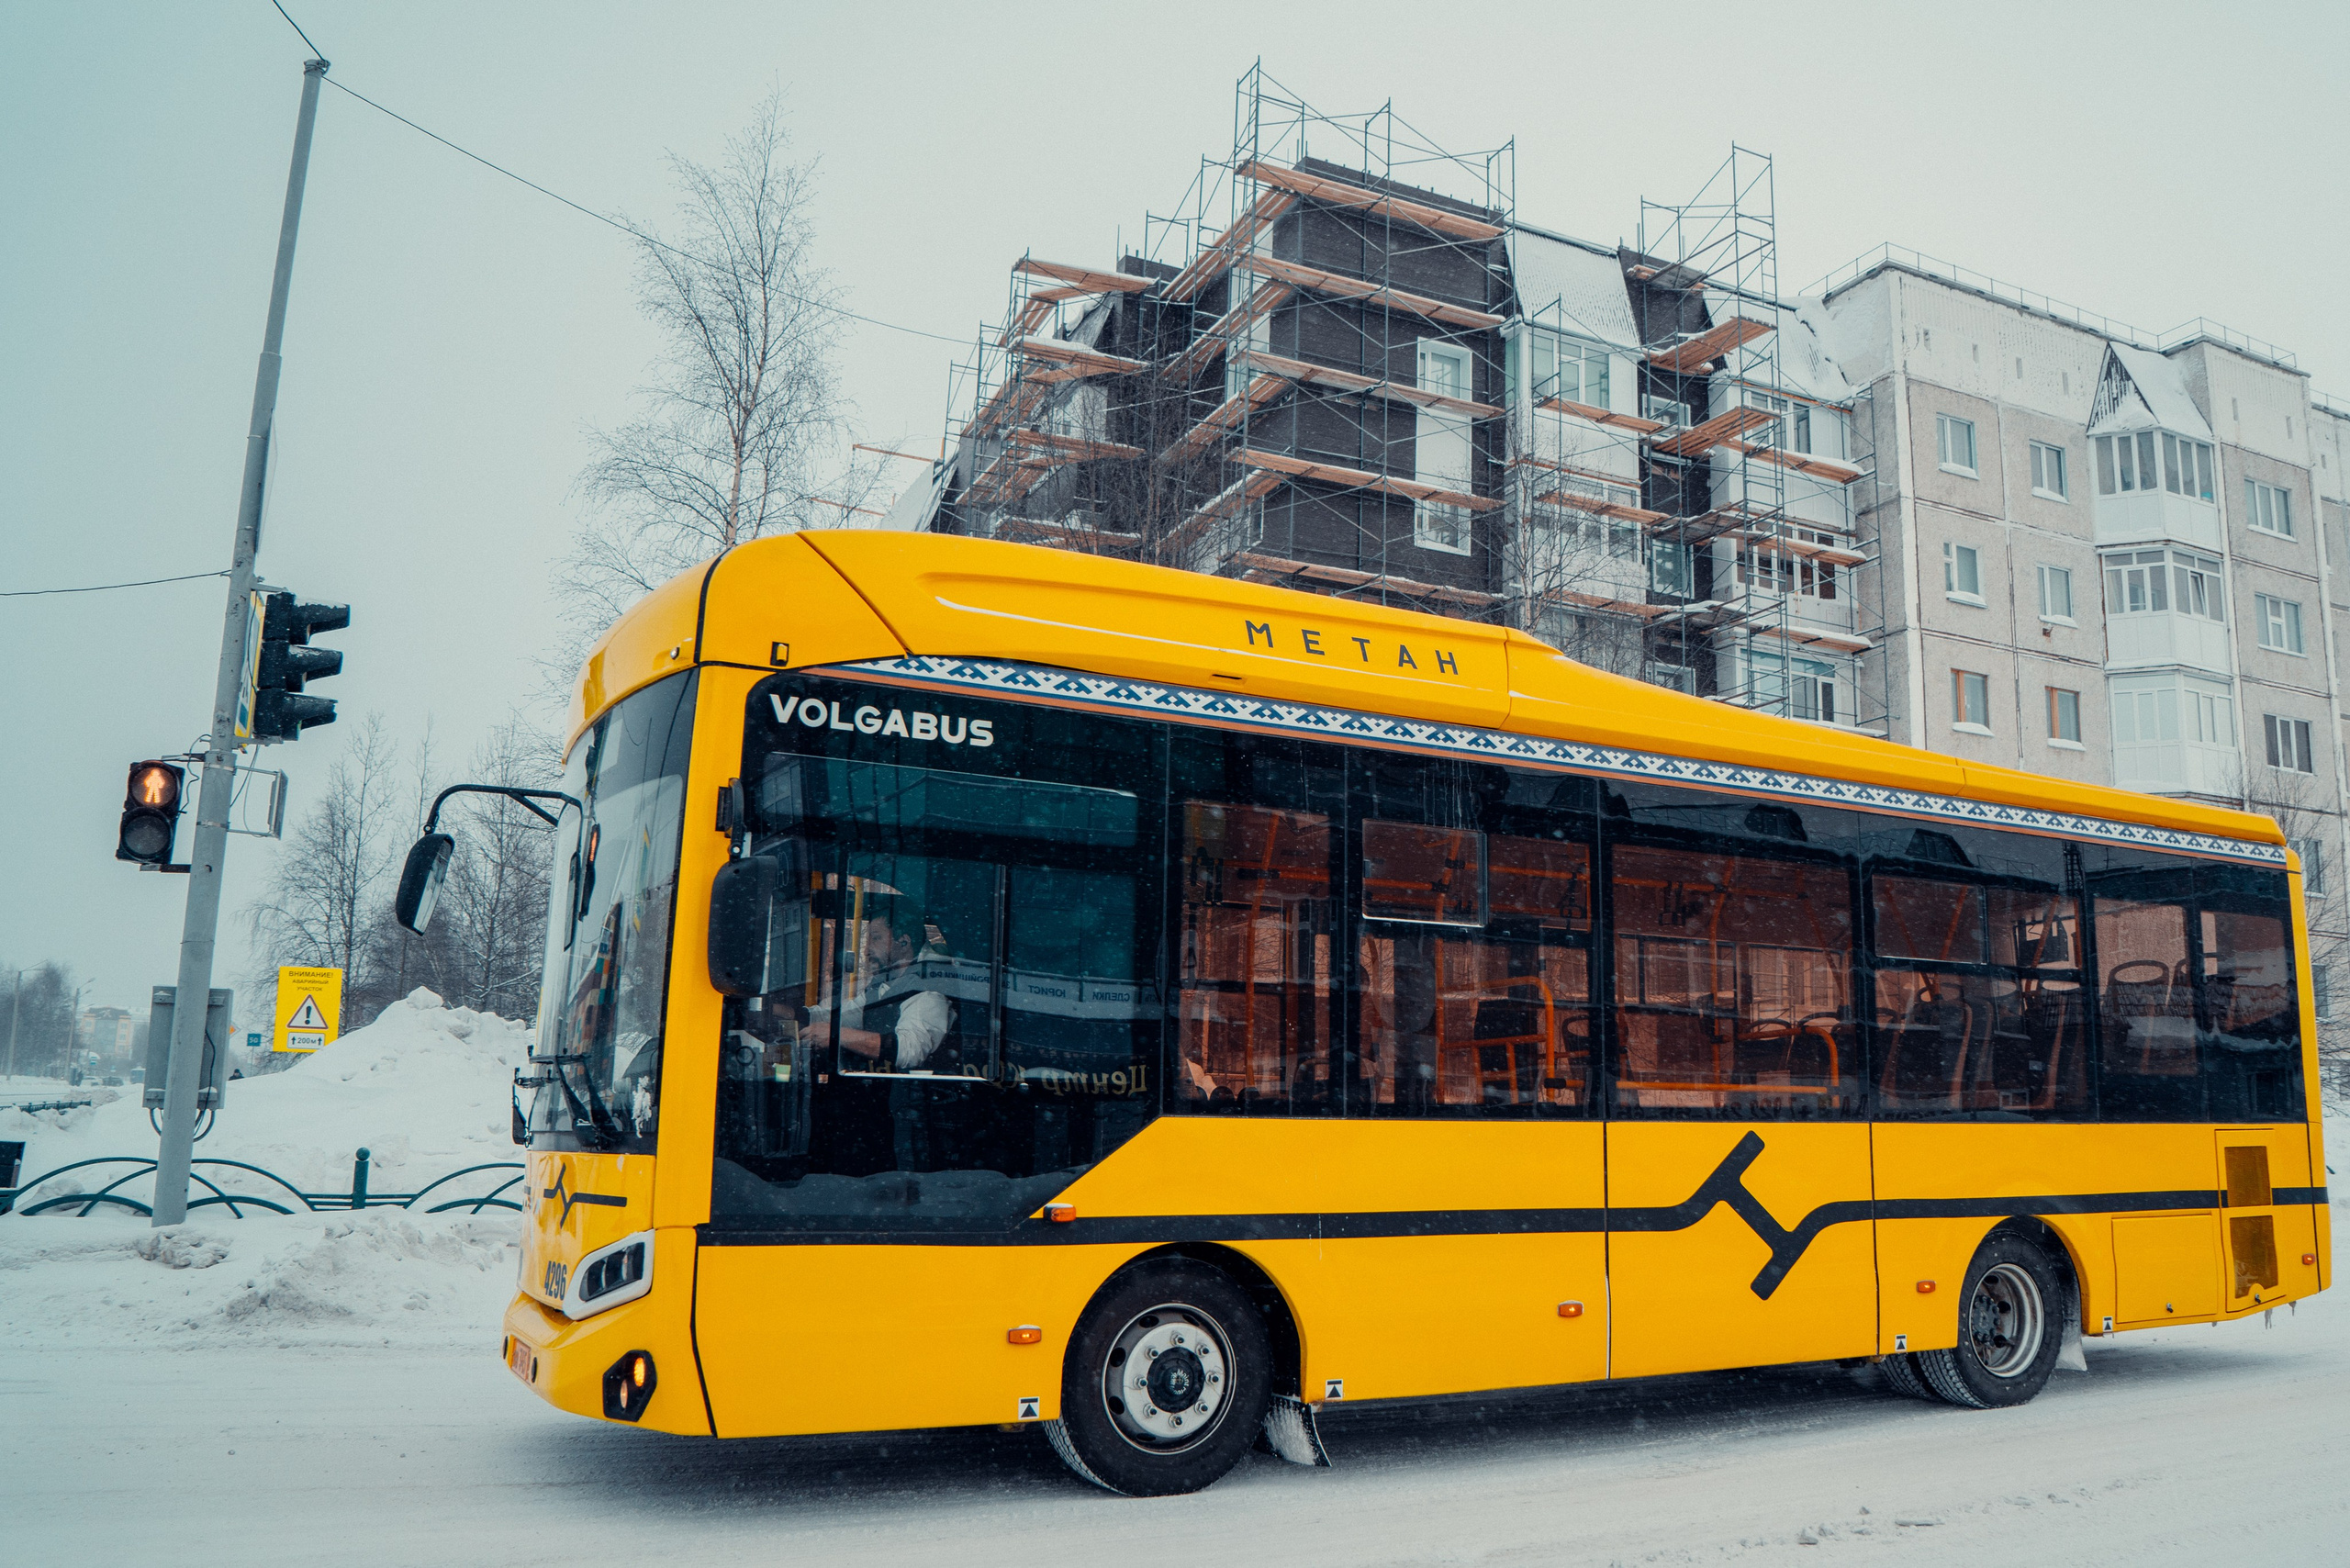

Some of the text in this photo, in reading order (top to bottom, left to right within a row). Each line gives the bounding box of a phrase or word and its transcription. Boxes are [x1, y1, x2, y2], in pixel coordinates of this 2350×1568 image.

[1245, 620, 1459, 675] МЕТАН
[769, 694, 994, 747] VOLGABUS
[288, 970, 334, 979] ВНИМАНИЕ!
[543, 1260, 567, 1301] 4296
